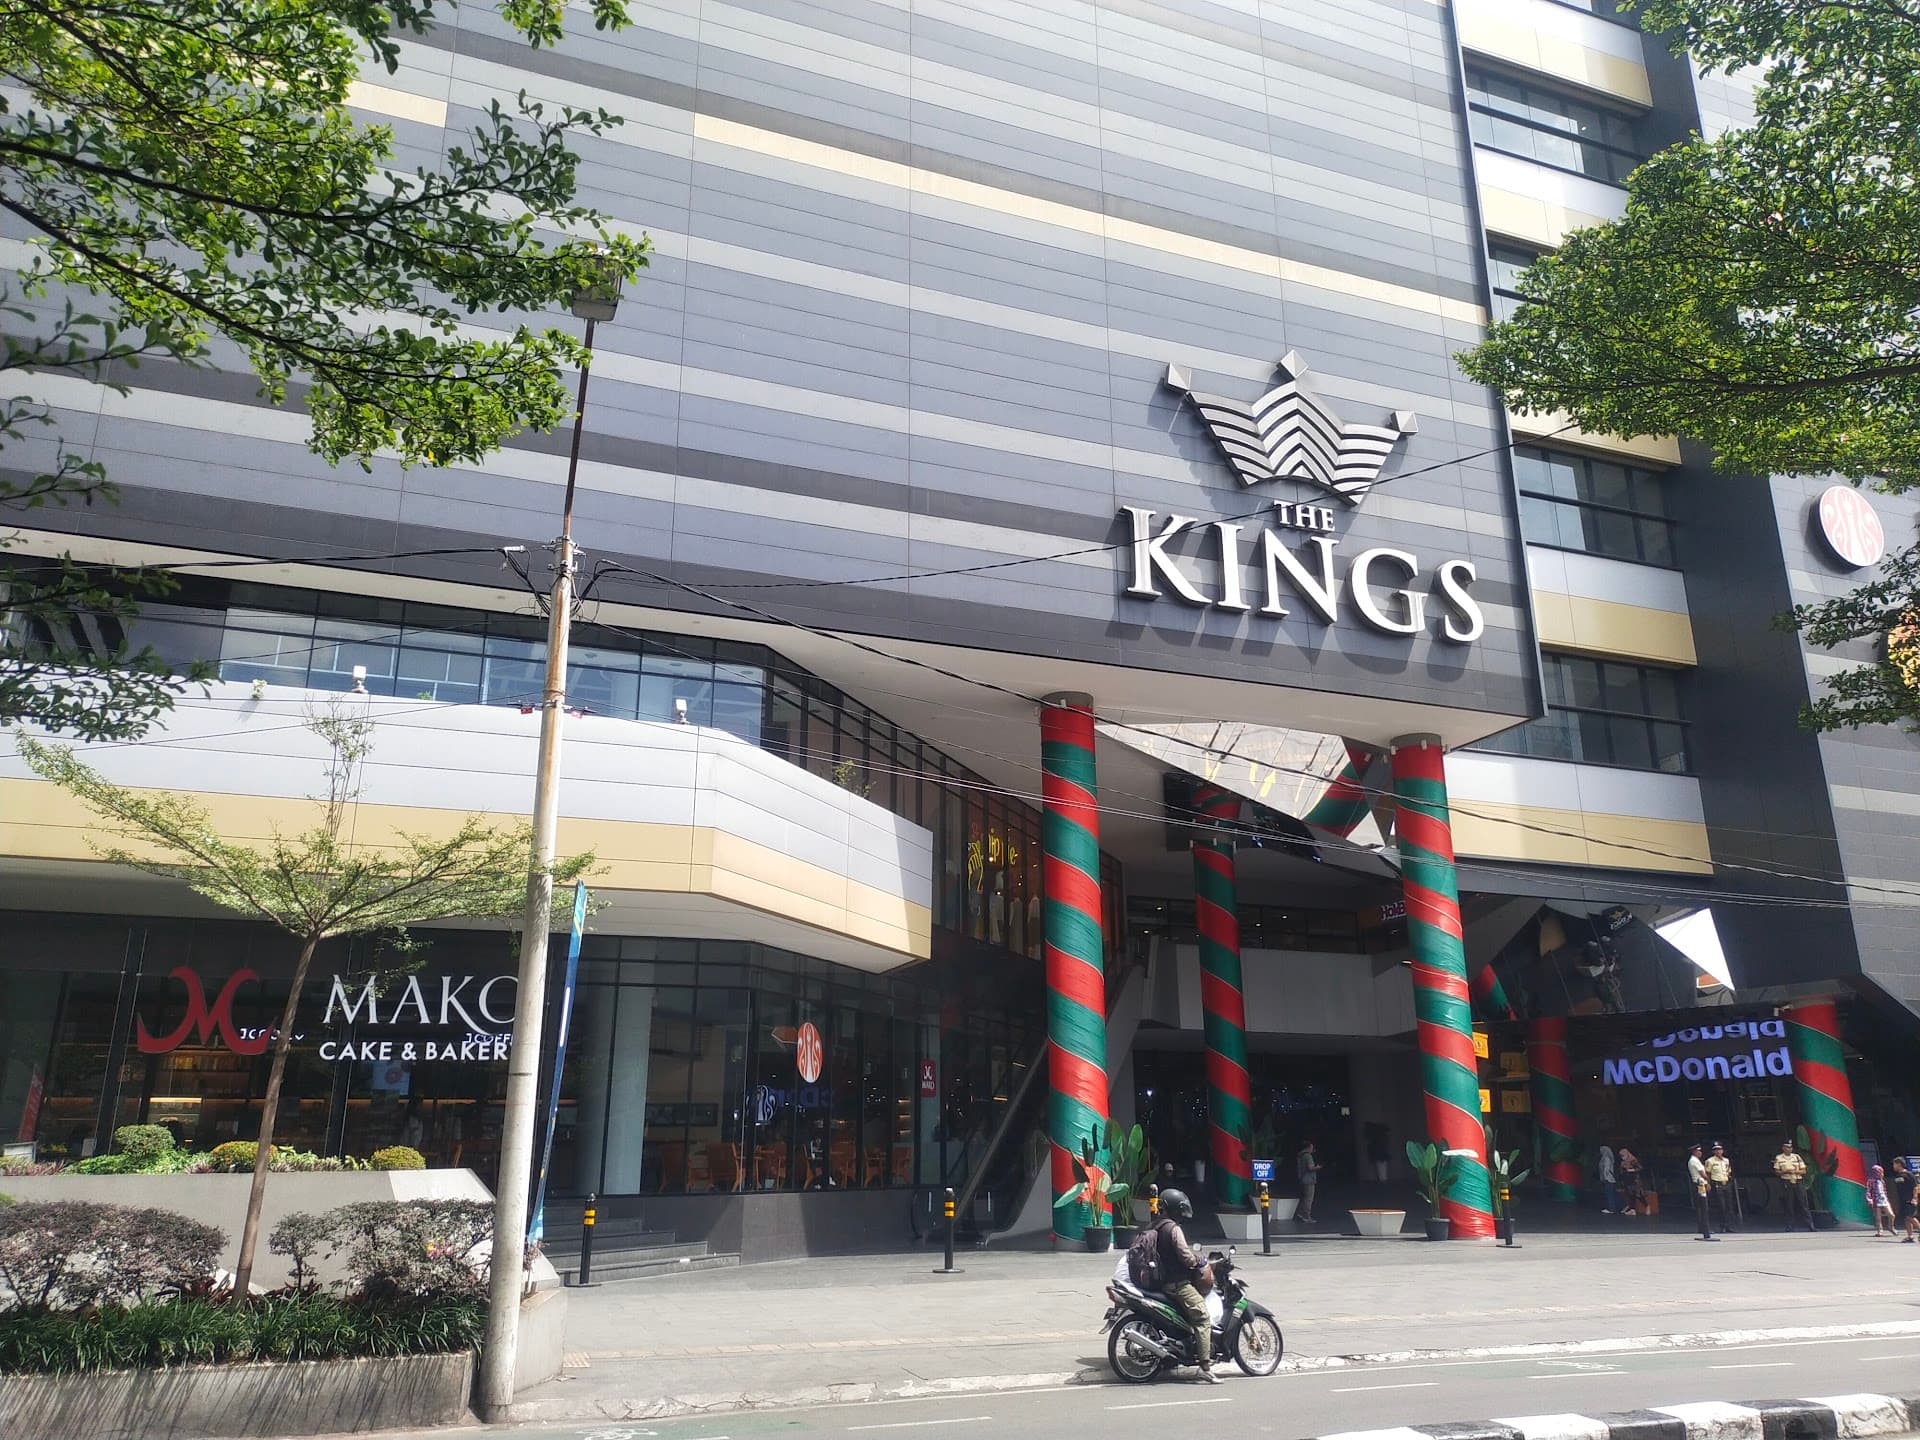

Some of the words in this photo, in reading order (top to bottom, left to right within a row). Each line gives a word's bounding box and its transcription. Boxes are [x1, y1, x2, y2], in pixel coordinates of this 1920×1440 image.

[1273, 499, 1336, 533] THE
[1119, 504, 1485, 643] KINGS
[319, 1041, 392, 1061] CAKE
[401, 1041, 417, 1061] &
[1603, 1047, 1793, 1085] McDonald
